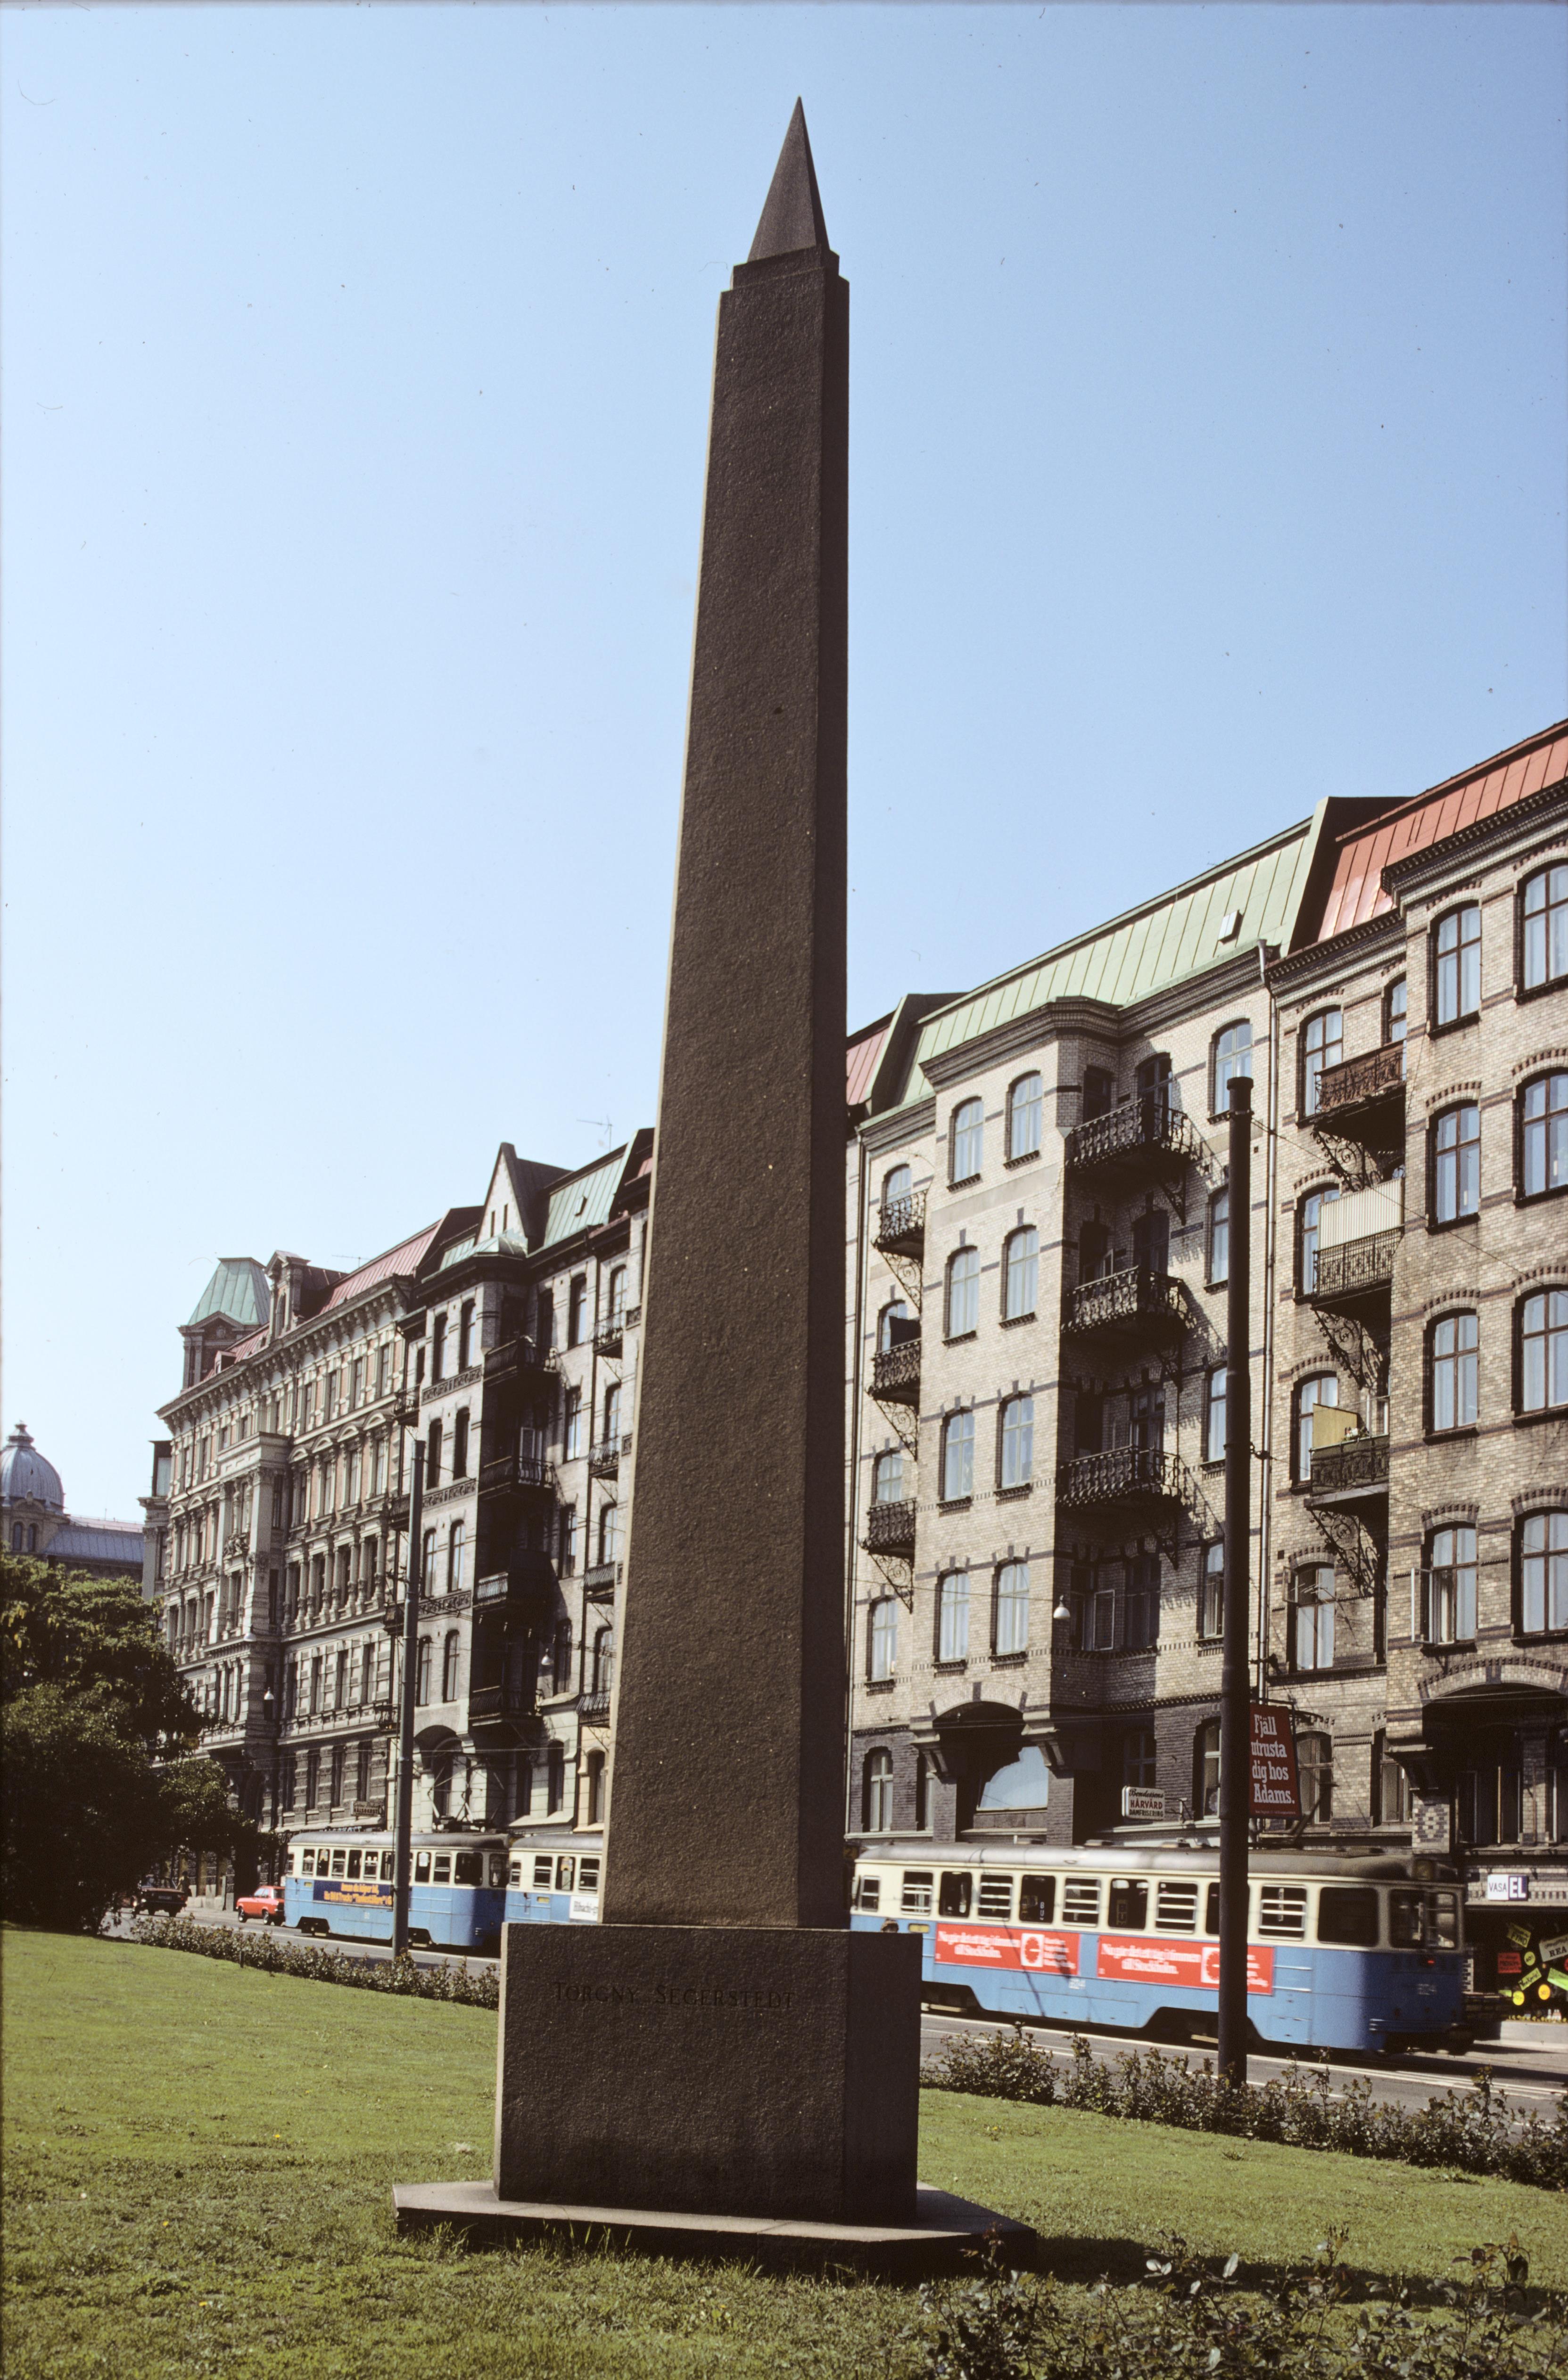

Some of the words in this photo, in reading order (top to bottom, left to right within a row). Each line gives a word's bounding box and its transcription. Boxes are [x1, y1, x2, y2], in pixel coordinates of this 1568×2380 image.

[1254, 1714, 1277, 1738] Fjäll
[1251, 1740, 1287, 1757] utrusta
[1252, 1760, 1267, 1783] dig
[1268, 1761, 1289, 1781] hos
[1131, 1798, 1163, 1809] HÅRVÅRD
[1254, 1783, 1295, 1804] Adams.
[1489, 1882, 1507, 1892] VASA
[1510, 1877, 1527, 1898] EL
[1549, 1946, 1567, 1957] REA
[553, 1982, 638, 2004] TORGNY
[655, 1985, 795, 2009] SEGERSTEDT
